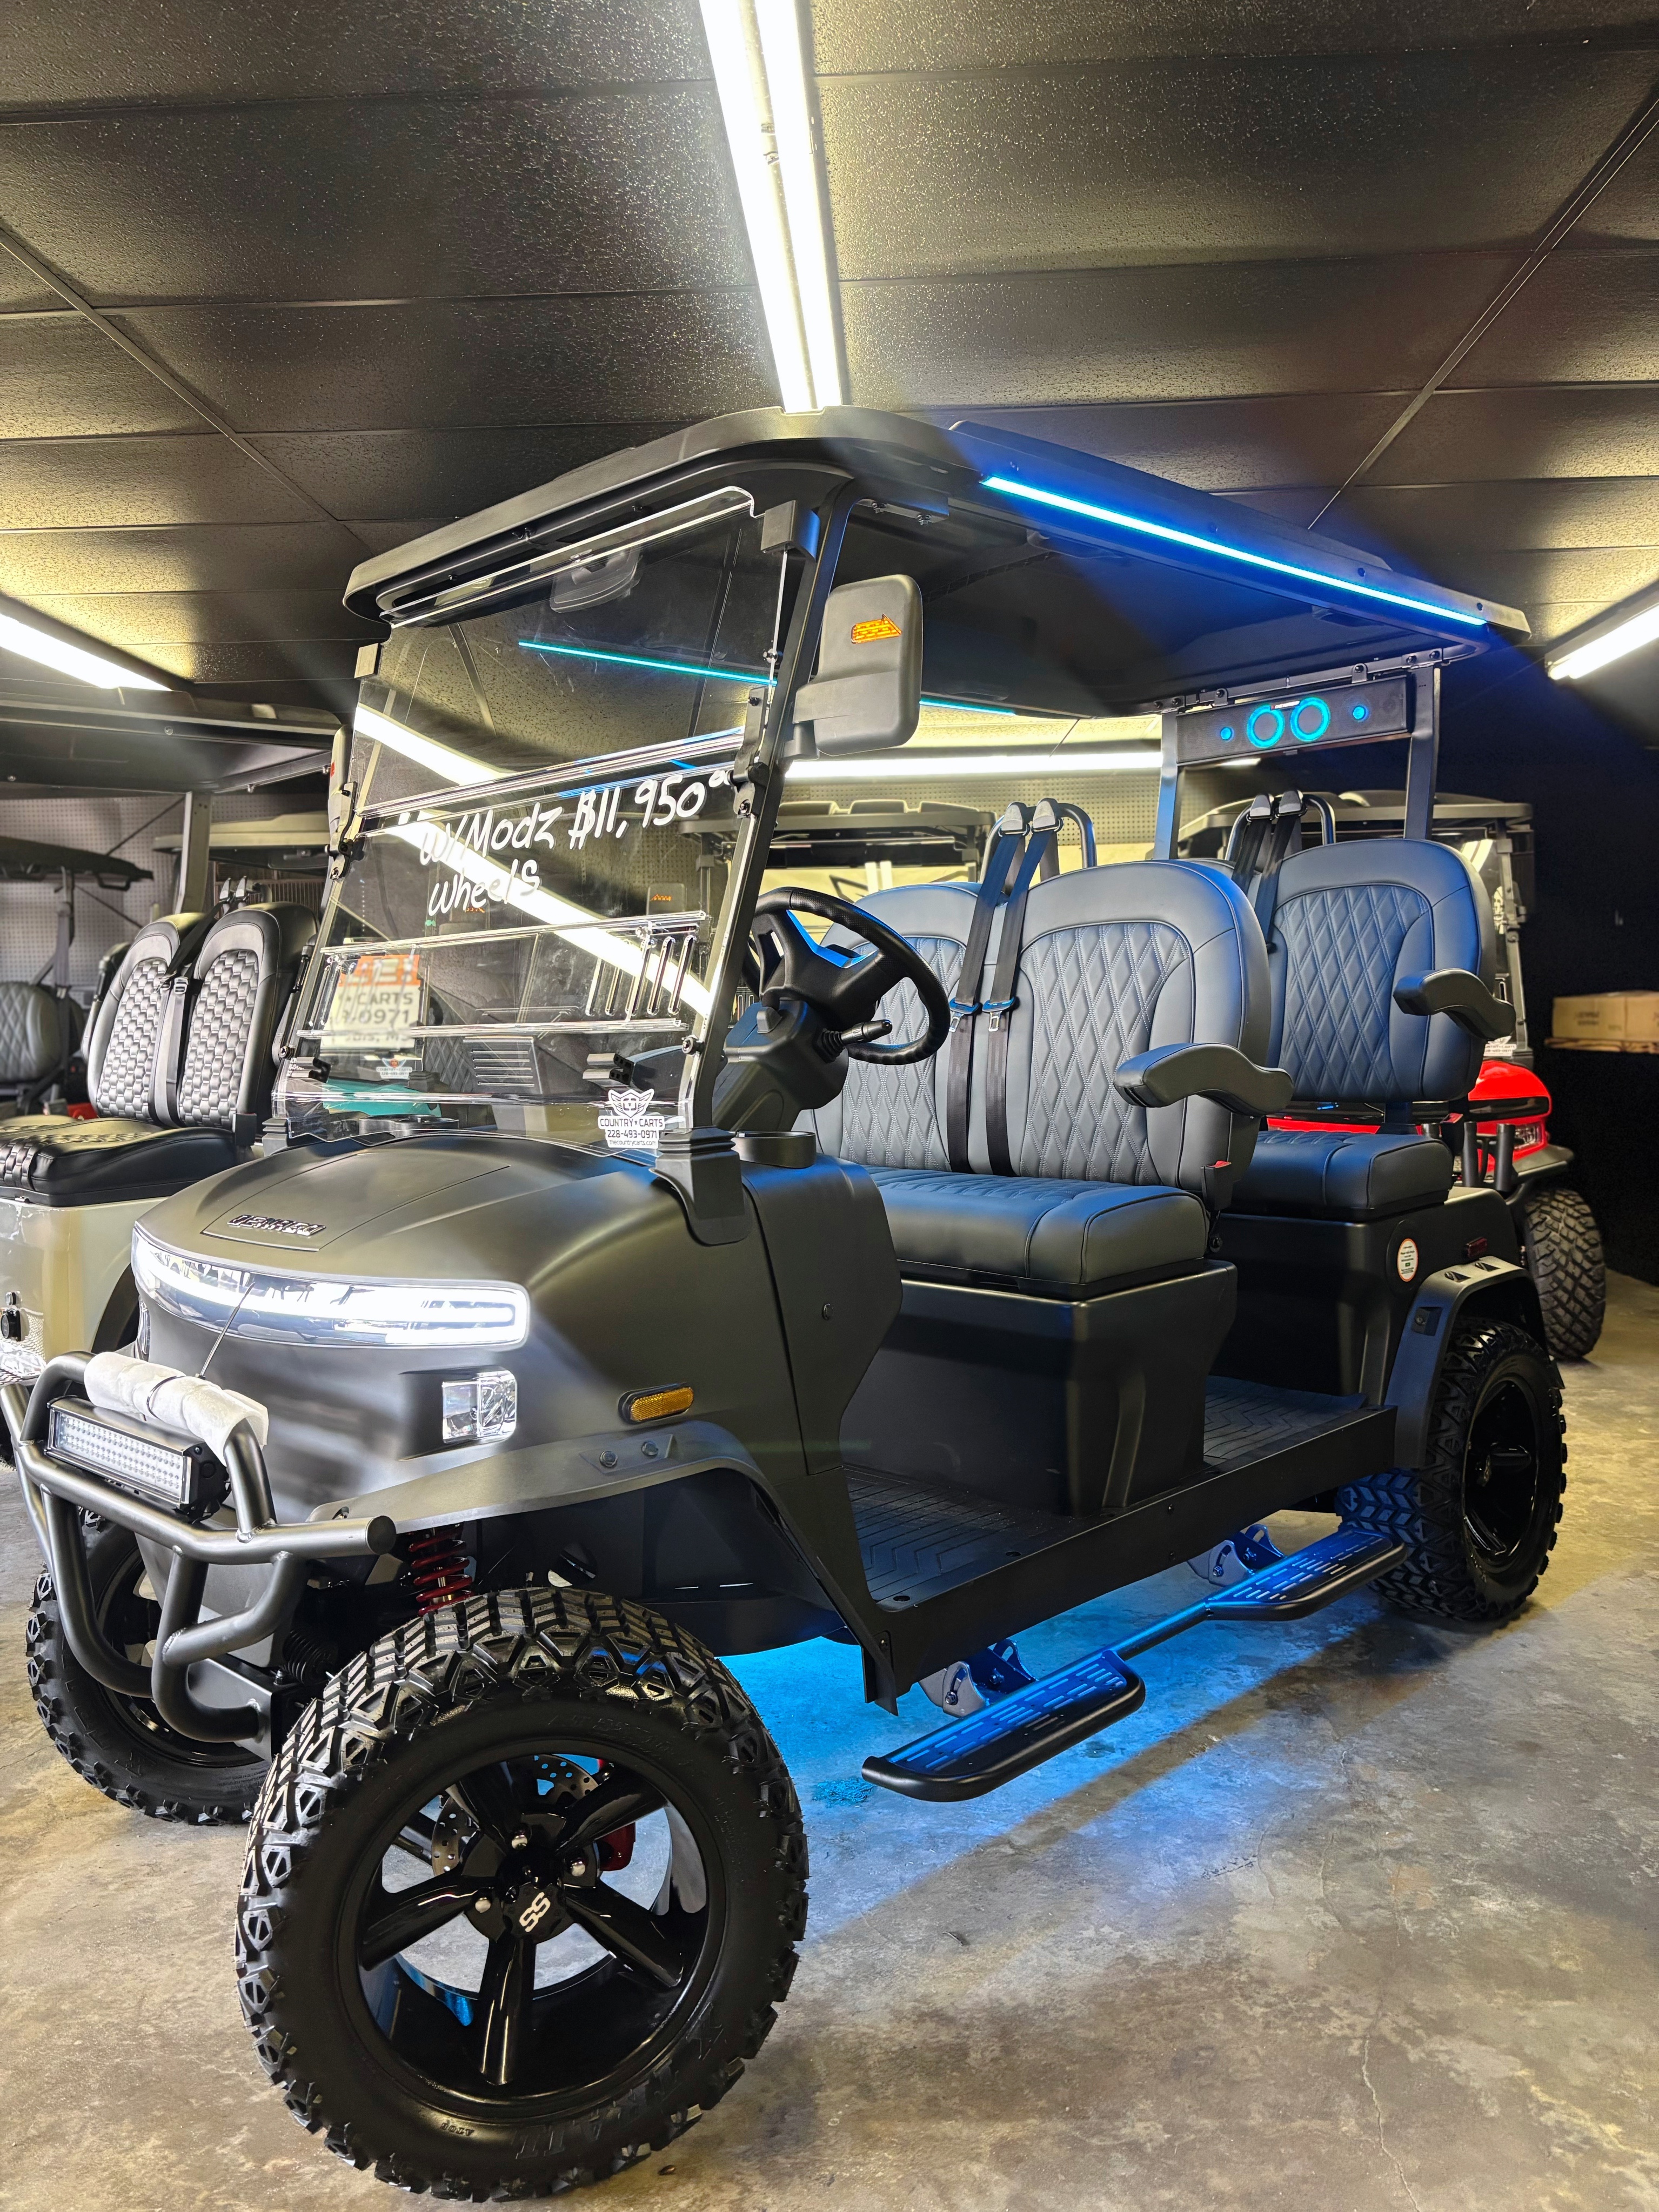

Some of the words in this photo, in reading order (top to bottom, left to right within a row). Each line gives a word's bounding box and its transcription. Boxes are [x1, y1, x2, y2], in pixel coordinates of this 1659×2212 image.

[357, 992, 413, 1006] CARTS
[600, 1118, 633, 1127] COUNTRY
[639, 1118, 663, 1128] CARTS
[607, 1129, 657, 1138] 228-493-0971
[519, 1892, 551, 1933] SS
